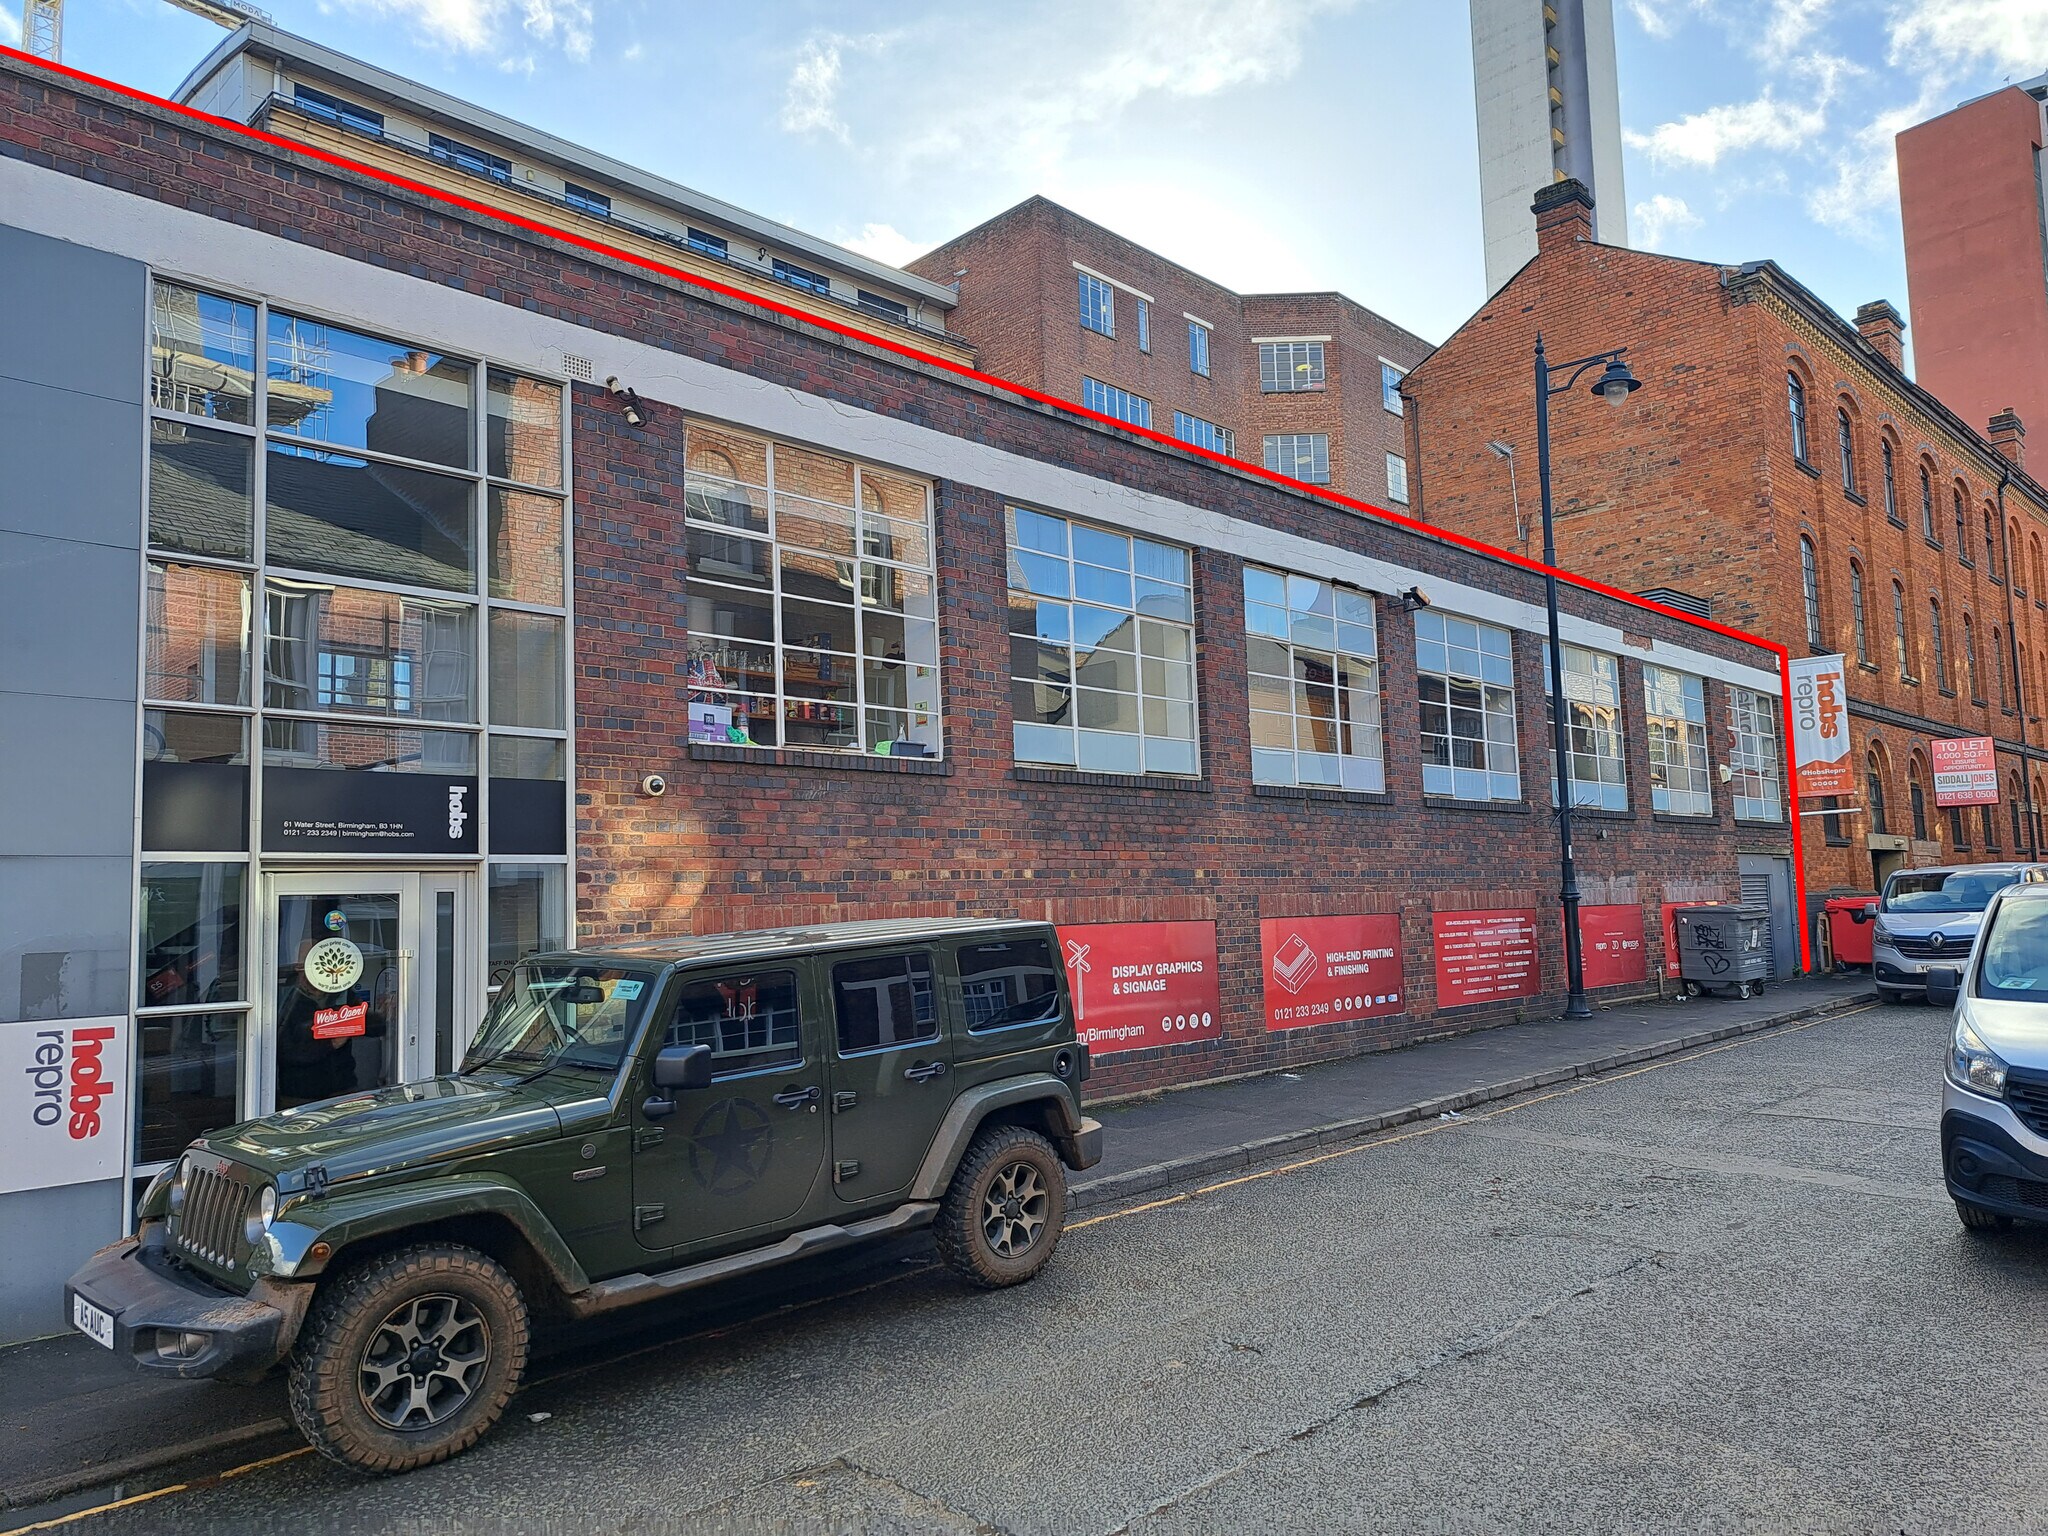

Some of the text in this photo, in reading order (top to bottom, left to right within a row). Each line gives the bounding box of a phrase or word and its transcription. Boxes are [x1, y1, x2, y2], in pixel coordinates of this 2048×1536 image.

[233, 1, 260, 17] MODA
[1793, 675, 1815, 731] repro
[1816, 671, 1843, 739] hobs
[1938, 739, 1986, 752] TO LET
[1801, 768, 1846, 776] @HobsRepro
[1937, 773, 1995, 790] SIDDALL JONES
[1938, 790, 1997, 800] 0121 638 0500
[449, 786, 468, 839] hobs
[283, 820, 292, 828] 61
[315, 821, 337, 829] Street,
[338, 822, 378, 830] Birmingham,
[379, 822, 388, 830] B3
[389, 822, 404, 830] 1HN
[321, 829, 338, 837] 2349
[342, 830, 414, 838] birmingham@hobs.com
[1326, 948, 1394, 963] HIGH-END PRINTING
[1112, 960, 1203, 979] DISPLAY GRAPHICS
[1327, 963, 1369, 977] & FINISHING
[1113, 979, 1167, 995] & SIGNAGE
[316, 1004, 366, 1024] We're Open!
[1274, 1002, 1330, 1020] 0121 233 2349
[25, 1030, 64, 1126] repro
[69, 1027, 115, 1139] hobs
[80, 1302, 105, 1339] A5 AUC
